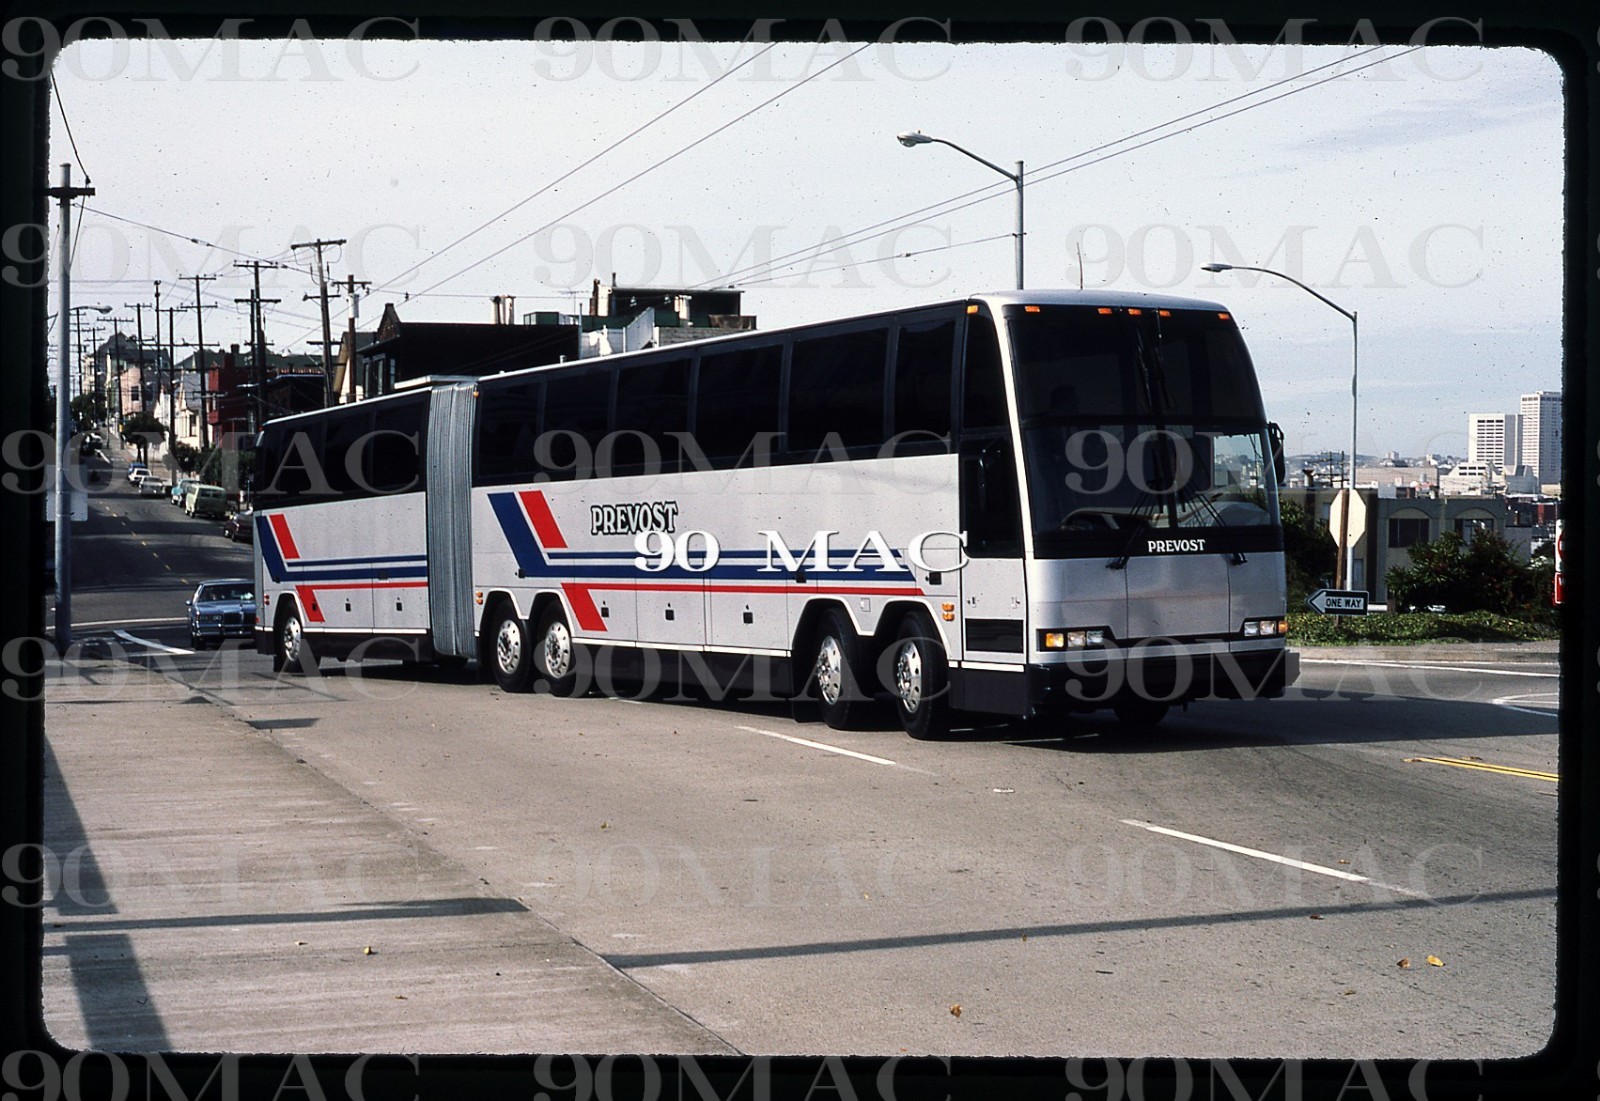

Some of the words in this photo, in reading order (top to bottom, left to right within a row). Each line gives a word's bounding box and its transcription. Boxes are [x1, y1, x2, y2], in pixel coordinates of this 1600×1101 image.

[591, 501, 679, 536] PREVOST
[1147, 538, 1206, 553] PREVOST
[1325, 598, 1342, 608] ONE
[1344, 598, 1362, 608] WAY
